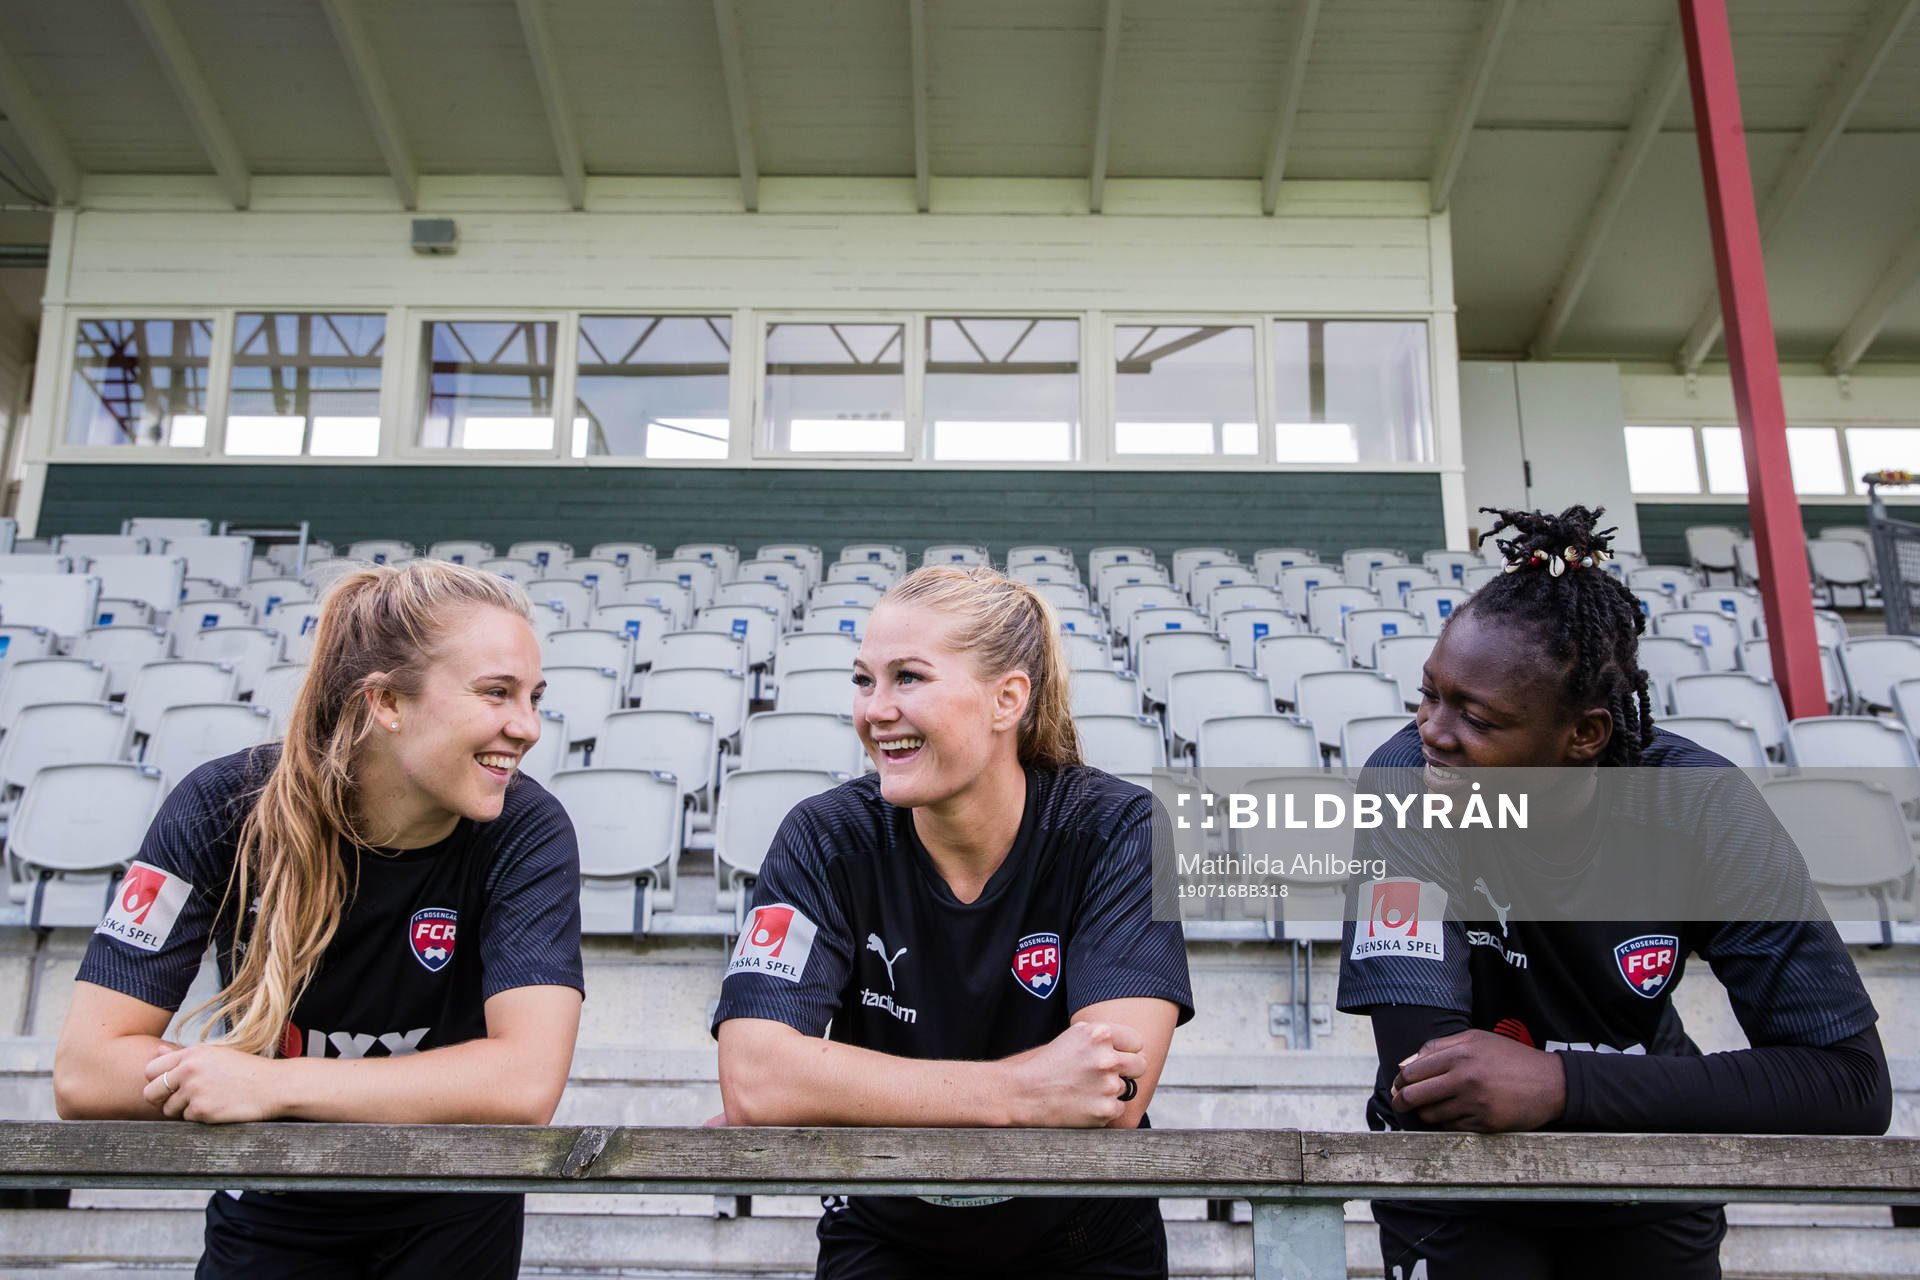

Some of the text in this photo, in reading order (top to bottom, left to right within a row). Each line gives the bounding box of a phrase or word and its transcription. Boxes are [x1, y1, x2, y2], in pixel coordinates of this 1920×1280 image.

[127, 927, 158, 947] SPEL
[415, 923, 457, 941] FCR
[1355, 940, 1441, 955] SVENSKA SPEL
[1620, 946, 1630, 955] FC
[766, 960, 797, 977] SPEL
[1018, 947, 1057, 971] FCR
[1628, 949, 1672, 973] FCR
[860, 988, 917, 1024] tadium
